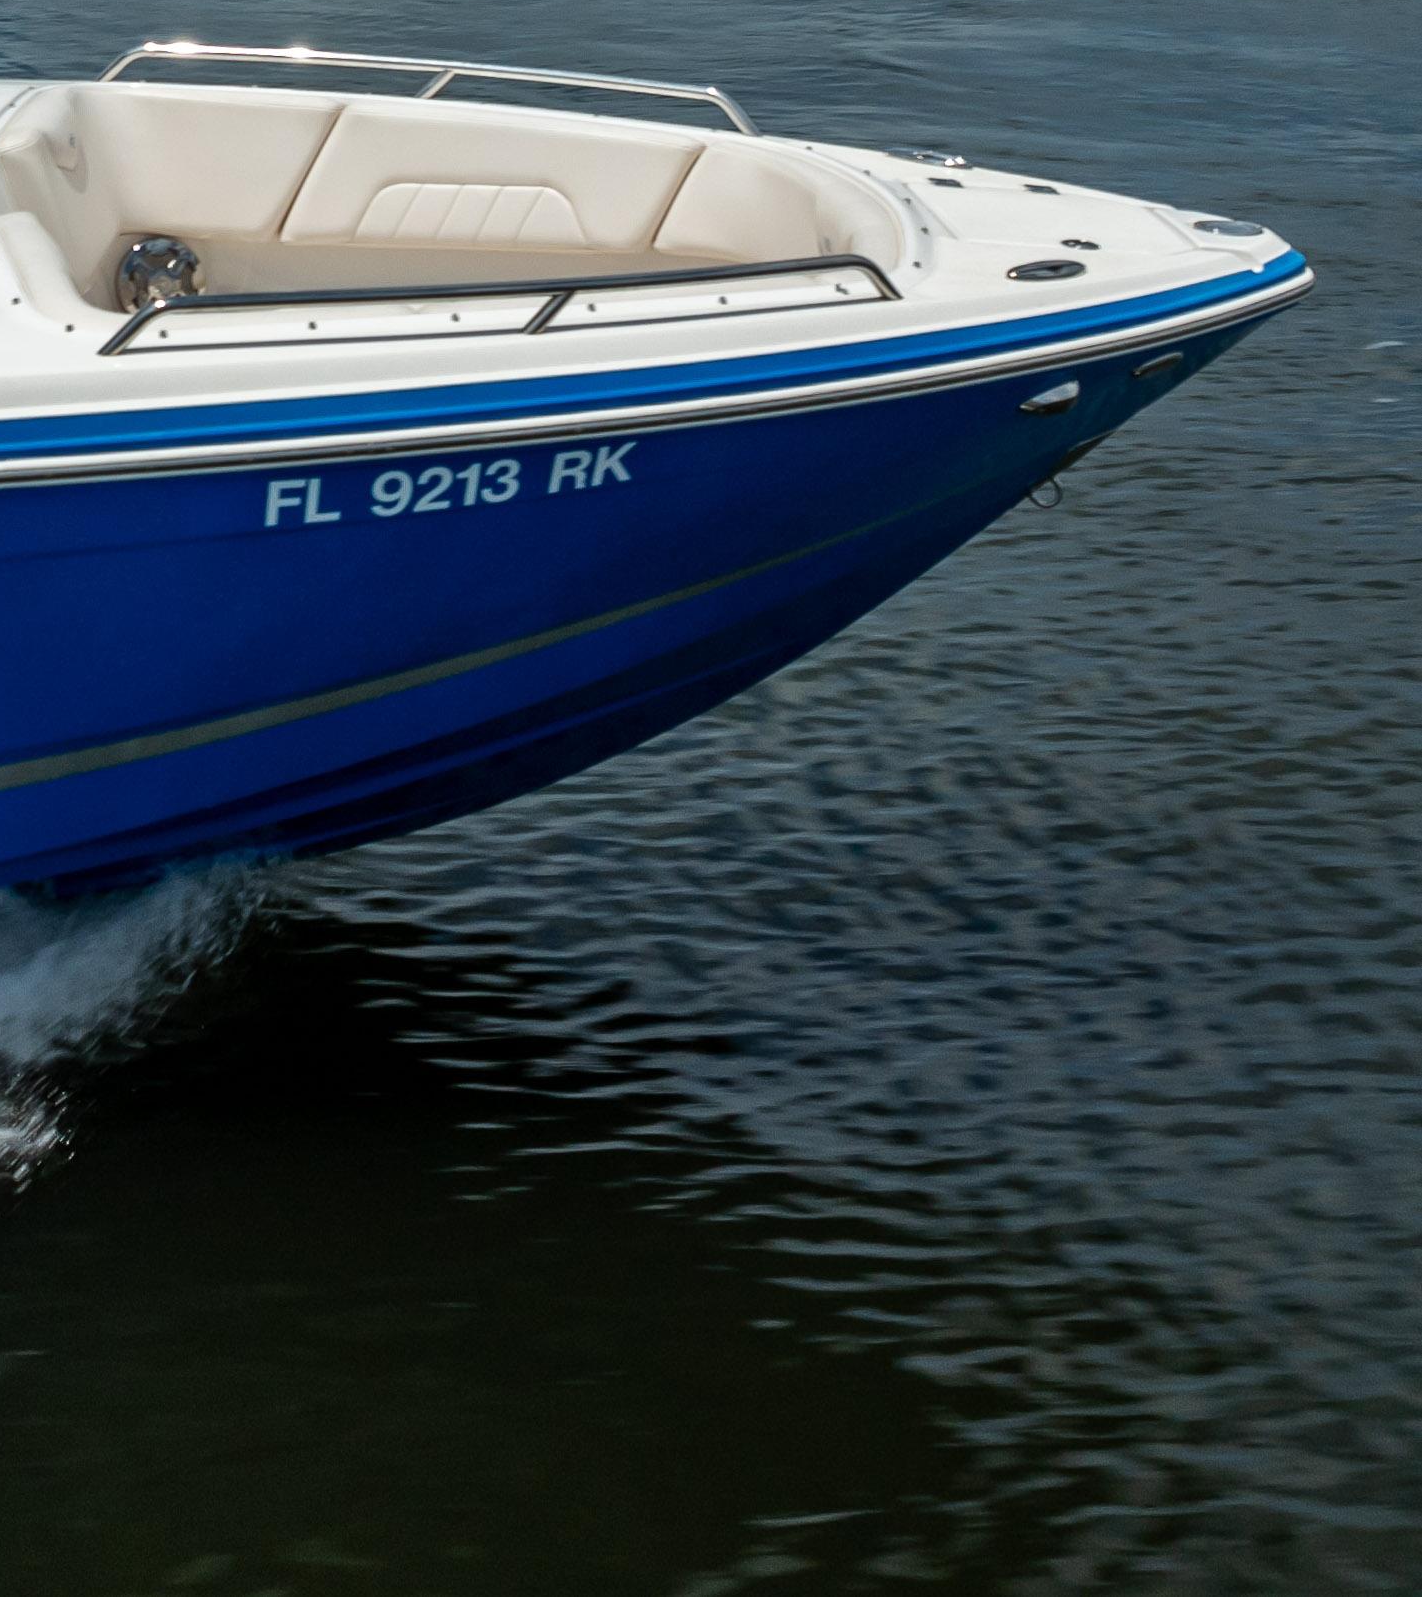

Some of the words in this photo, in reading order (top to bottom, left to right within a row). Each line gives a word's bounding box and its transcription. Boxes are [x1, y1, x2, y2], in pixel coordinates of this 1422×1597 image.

[264, 477, 342, 527] FL
[369, 459, 521, 518] 9213
[548, 441, 637, 494] RK
